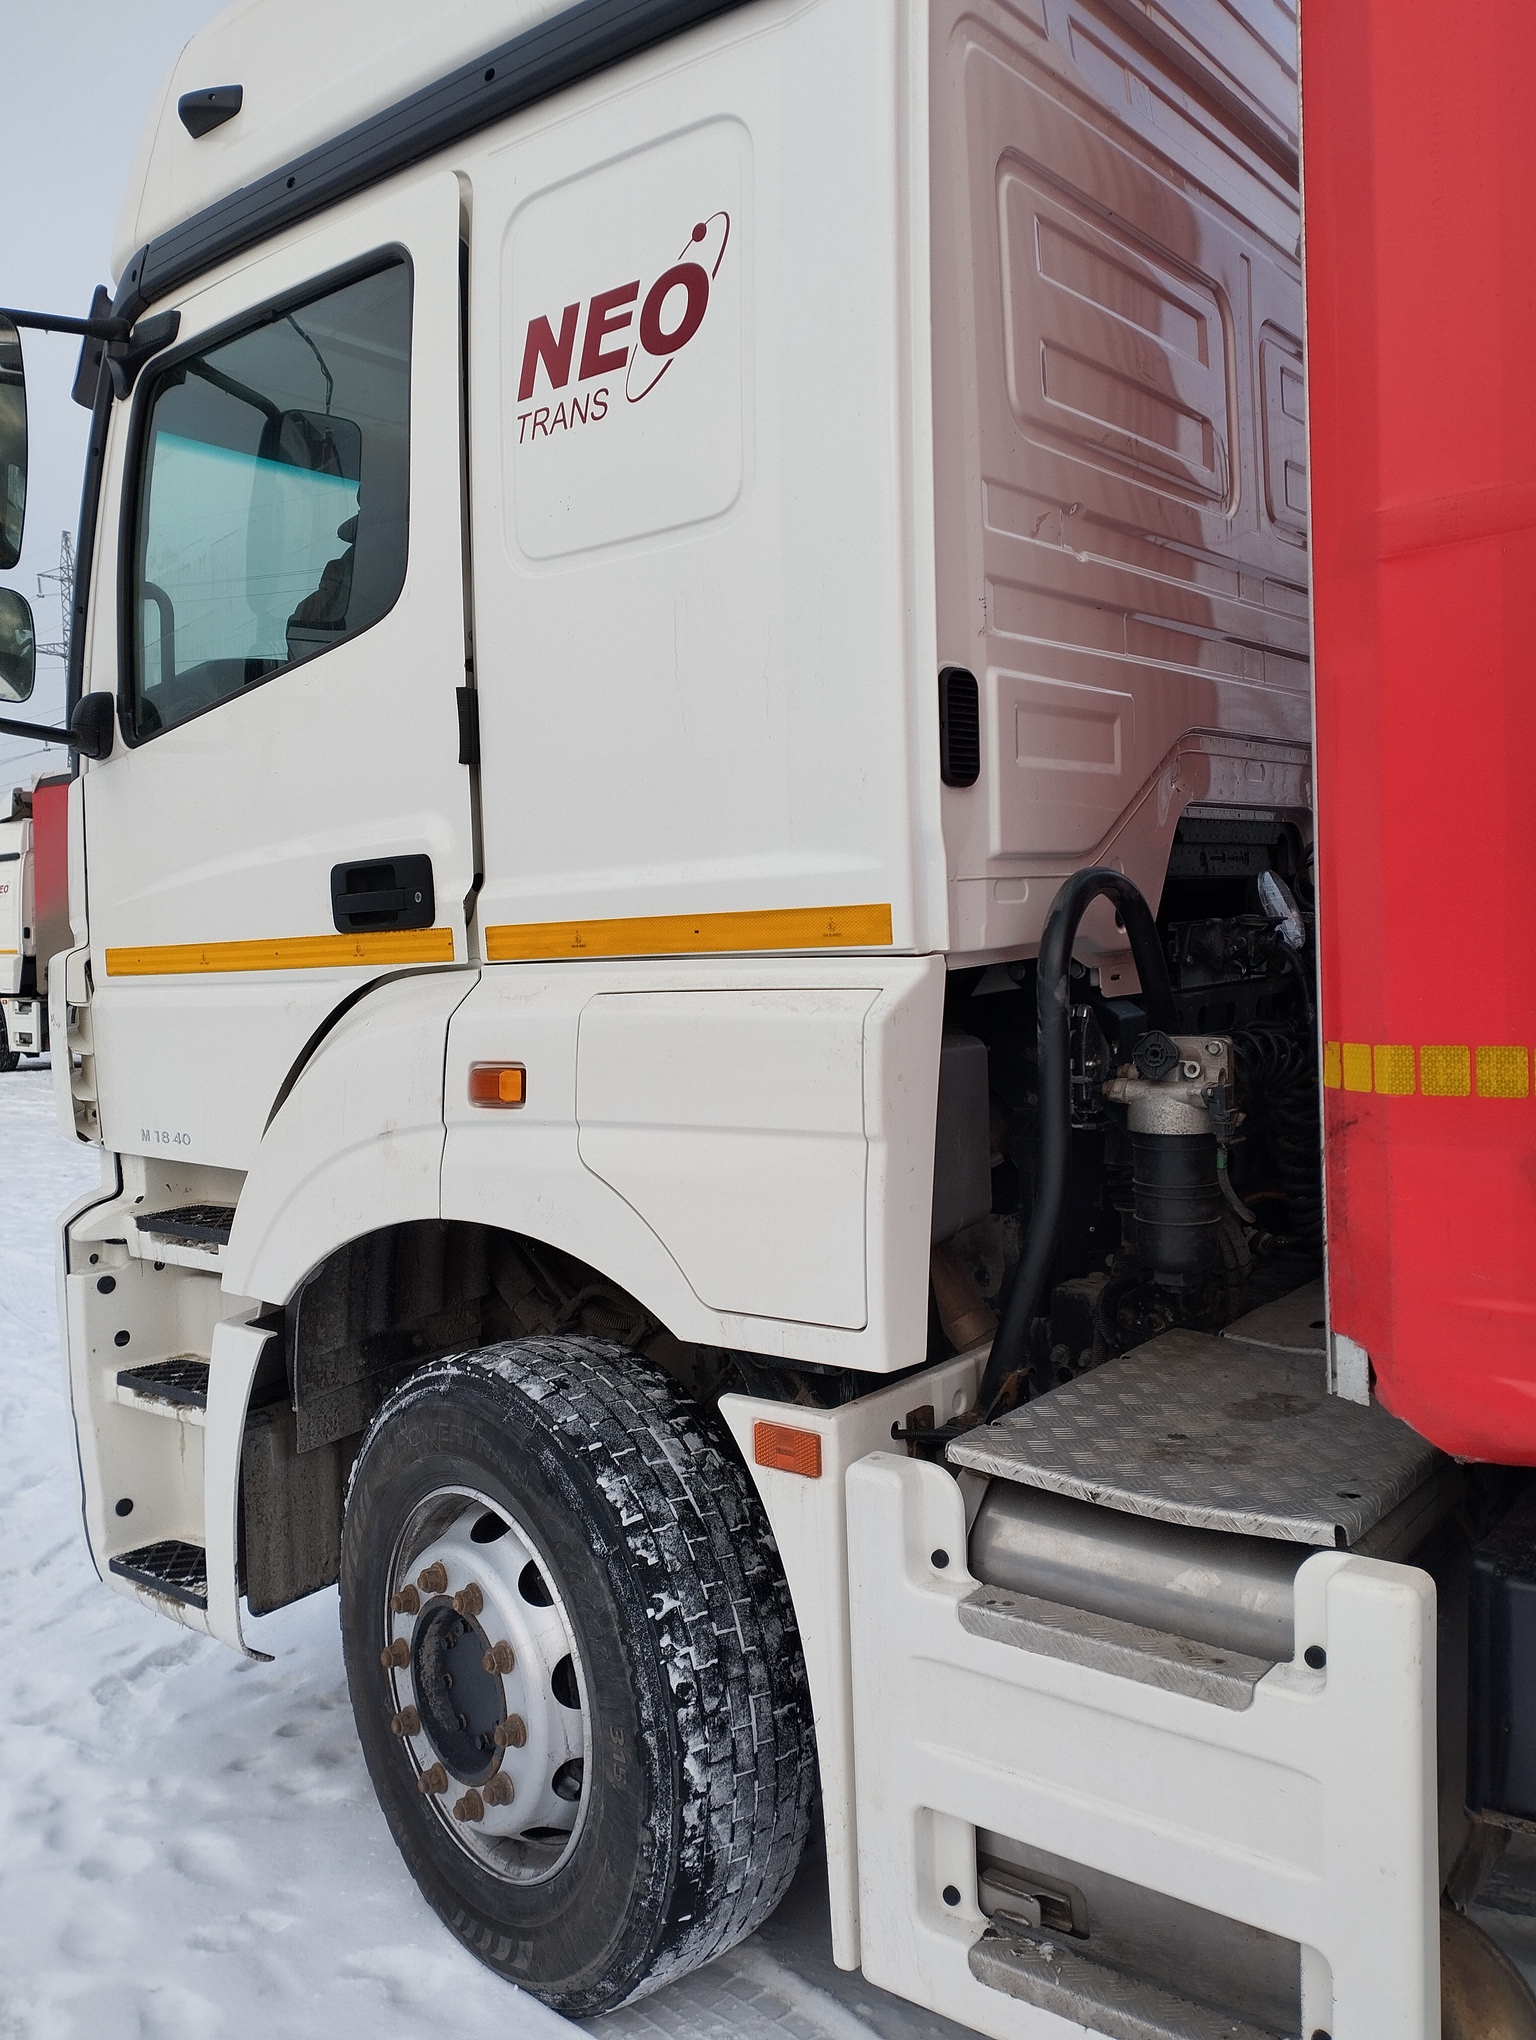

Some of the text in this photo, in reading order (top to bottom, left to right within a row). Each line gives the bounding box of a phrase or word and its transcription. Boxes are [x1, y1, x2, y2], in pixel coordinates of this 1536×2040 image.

[517, 262, 710, 402] NEO
[517, 388, 610, 444] TRANS
[0, 884, 9, 894] EO
[141, 1128, 151, 1142] M
